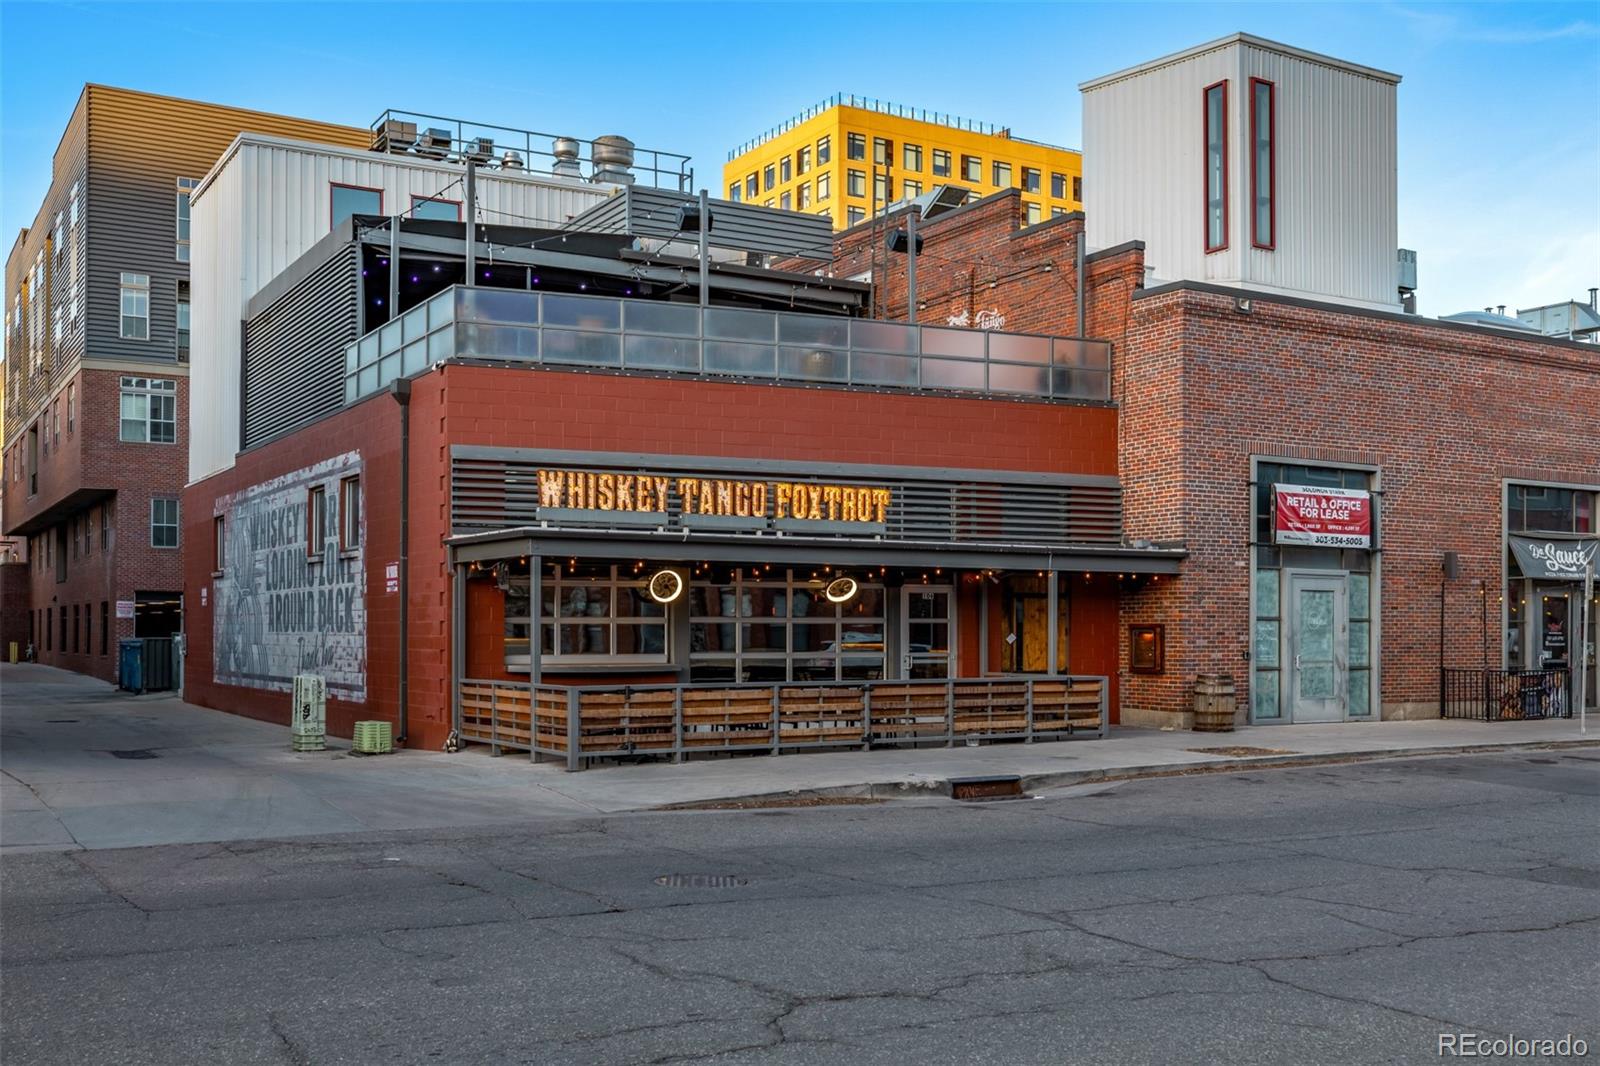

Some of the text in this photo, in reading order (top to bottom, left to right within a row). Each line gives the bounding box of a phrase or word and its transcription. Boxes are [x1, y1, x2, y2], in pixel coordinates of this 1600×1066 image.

[536, 469, 891, 522] WHISKEY TANGO FOXTROT
[1287, 497, 1361, 511] RETAIL & OFFICE
[1300, 508, 1350, 520] FOR LEASE
[250, 503, 300, 551] WHISKEY
[1315, 535, 1364, 546] 303-534-5005
[266, 546, 315, 591] LOADING
[1545, 542, 1590, 571] Sauce
[268, 587, 356, 633] AROUND BACK
